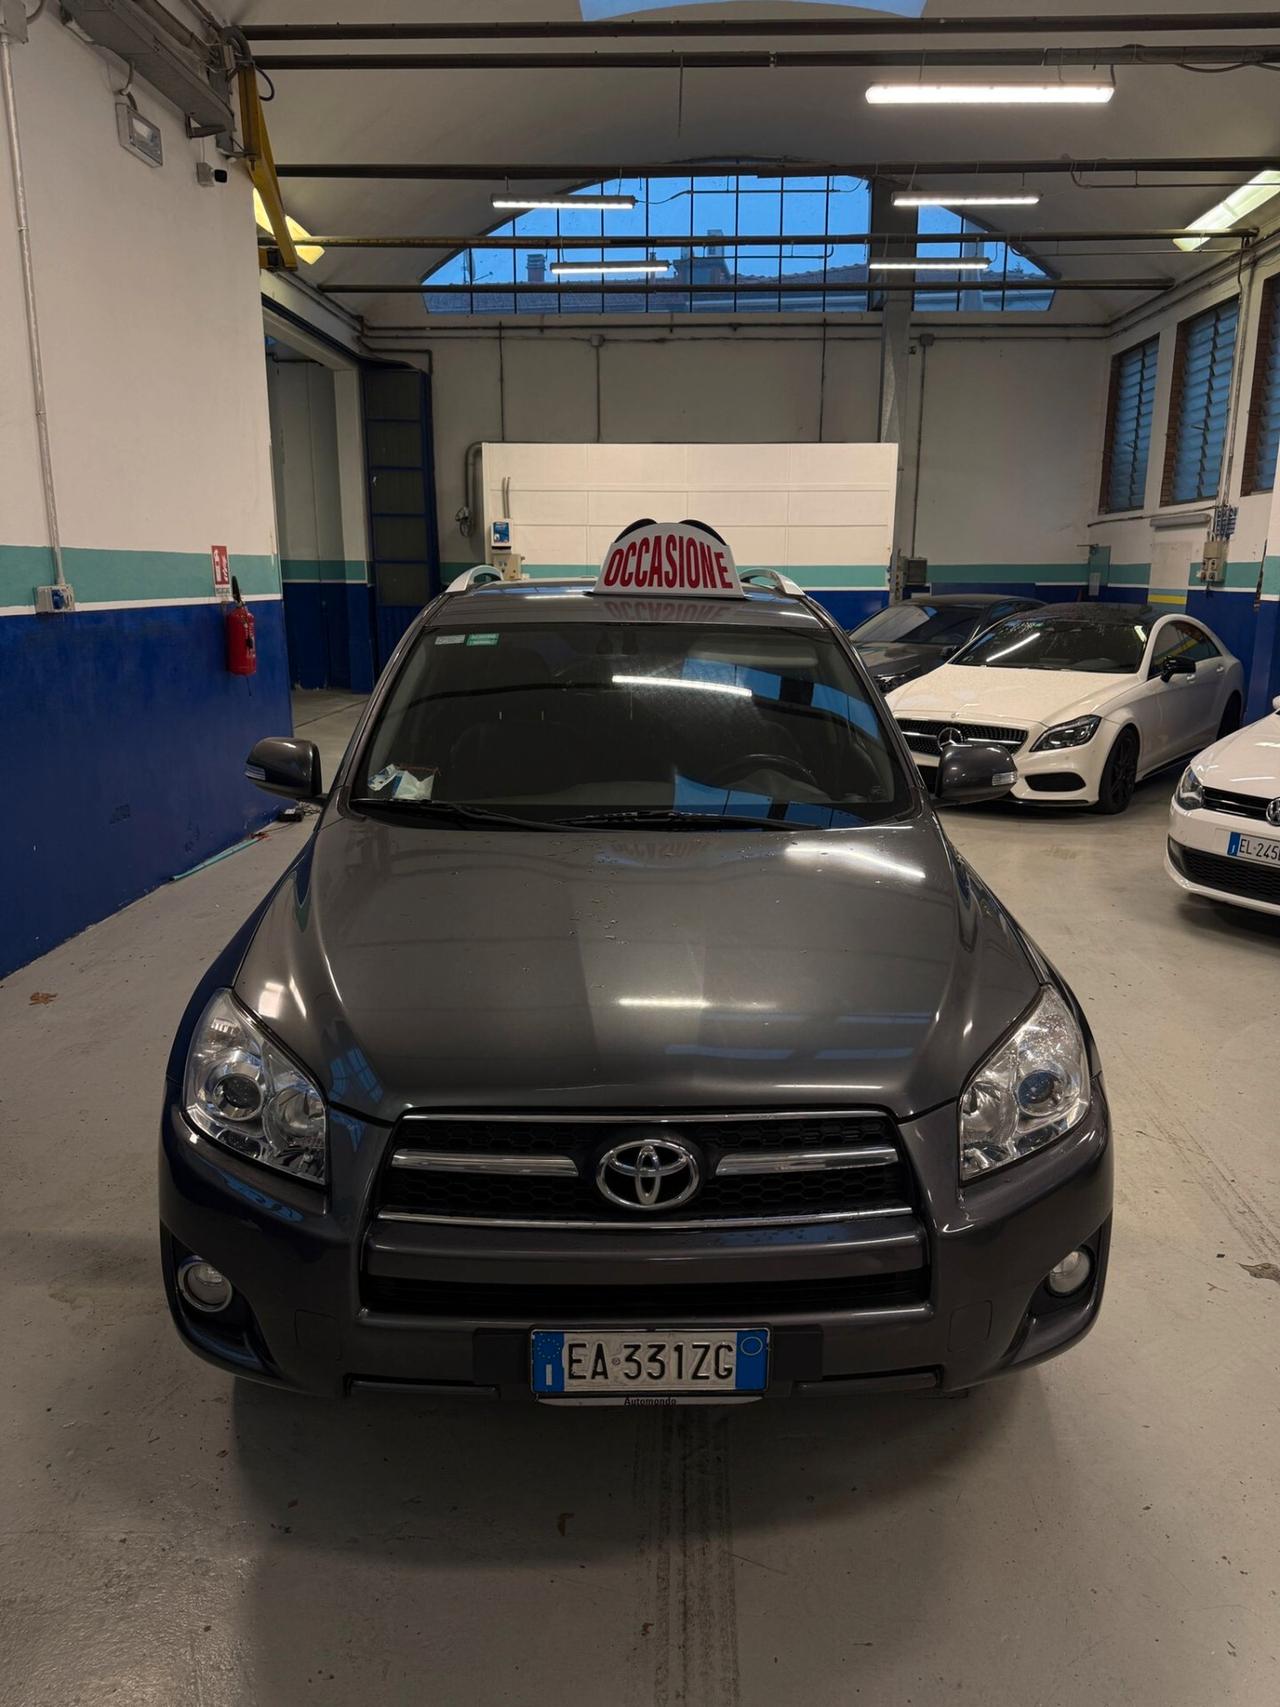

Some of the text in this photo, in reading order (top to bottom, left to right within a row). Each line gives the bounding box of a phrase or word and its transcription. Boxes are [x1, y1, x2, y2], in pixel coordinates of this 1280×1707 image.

[604, 534, 733, 589] OCCASIONE
[1240, 838, 1280, 861] EL 245
[568, 1343, 734, 1380] EA 331ZG
